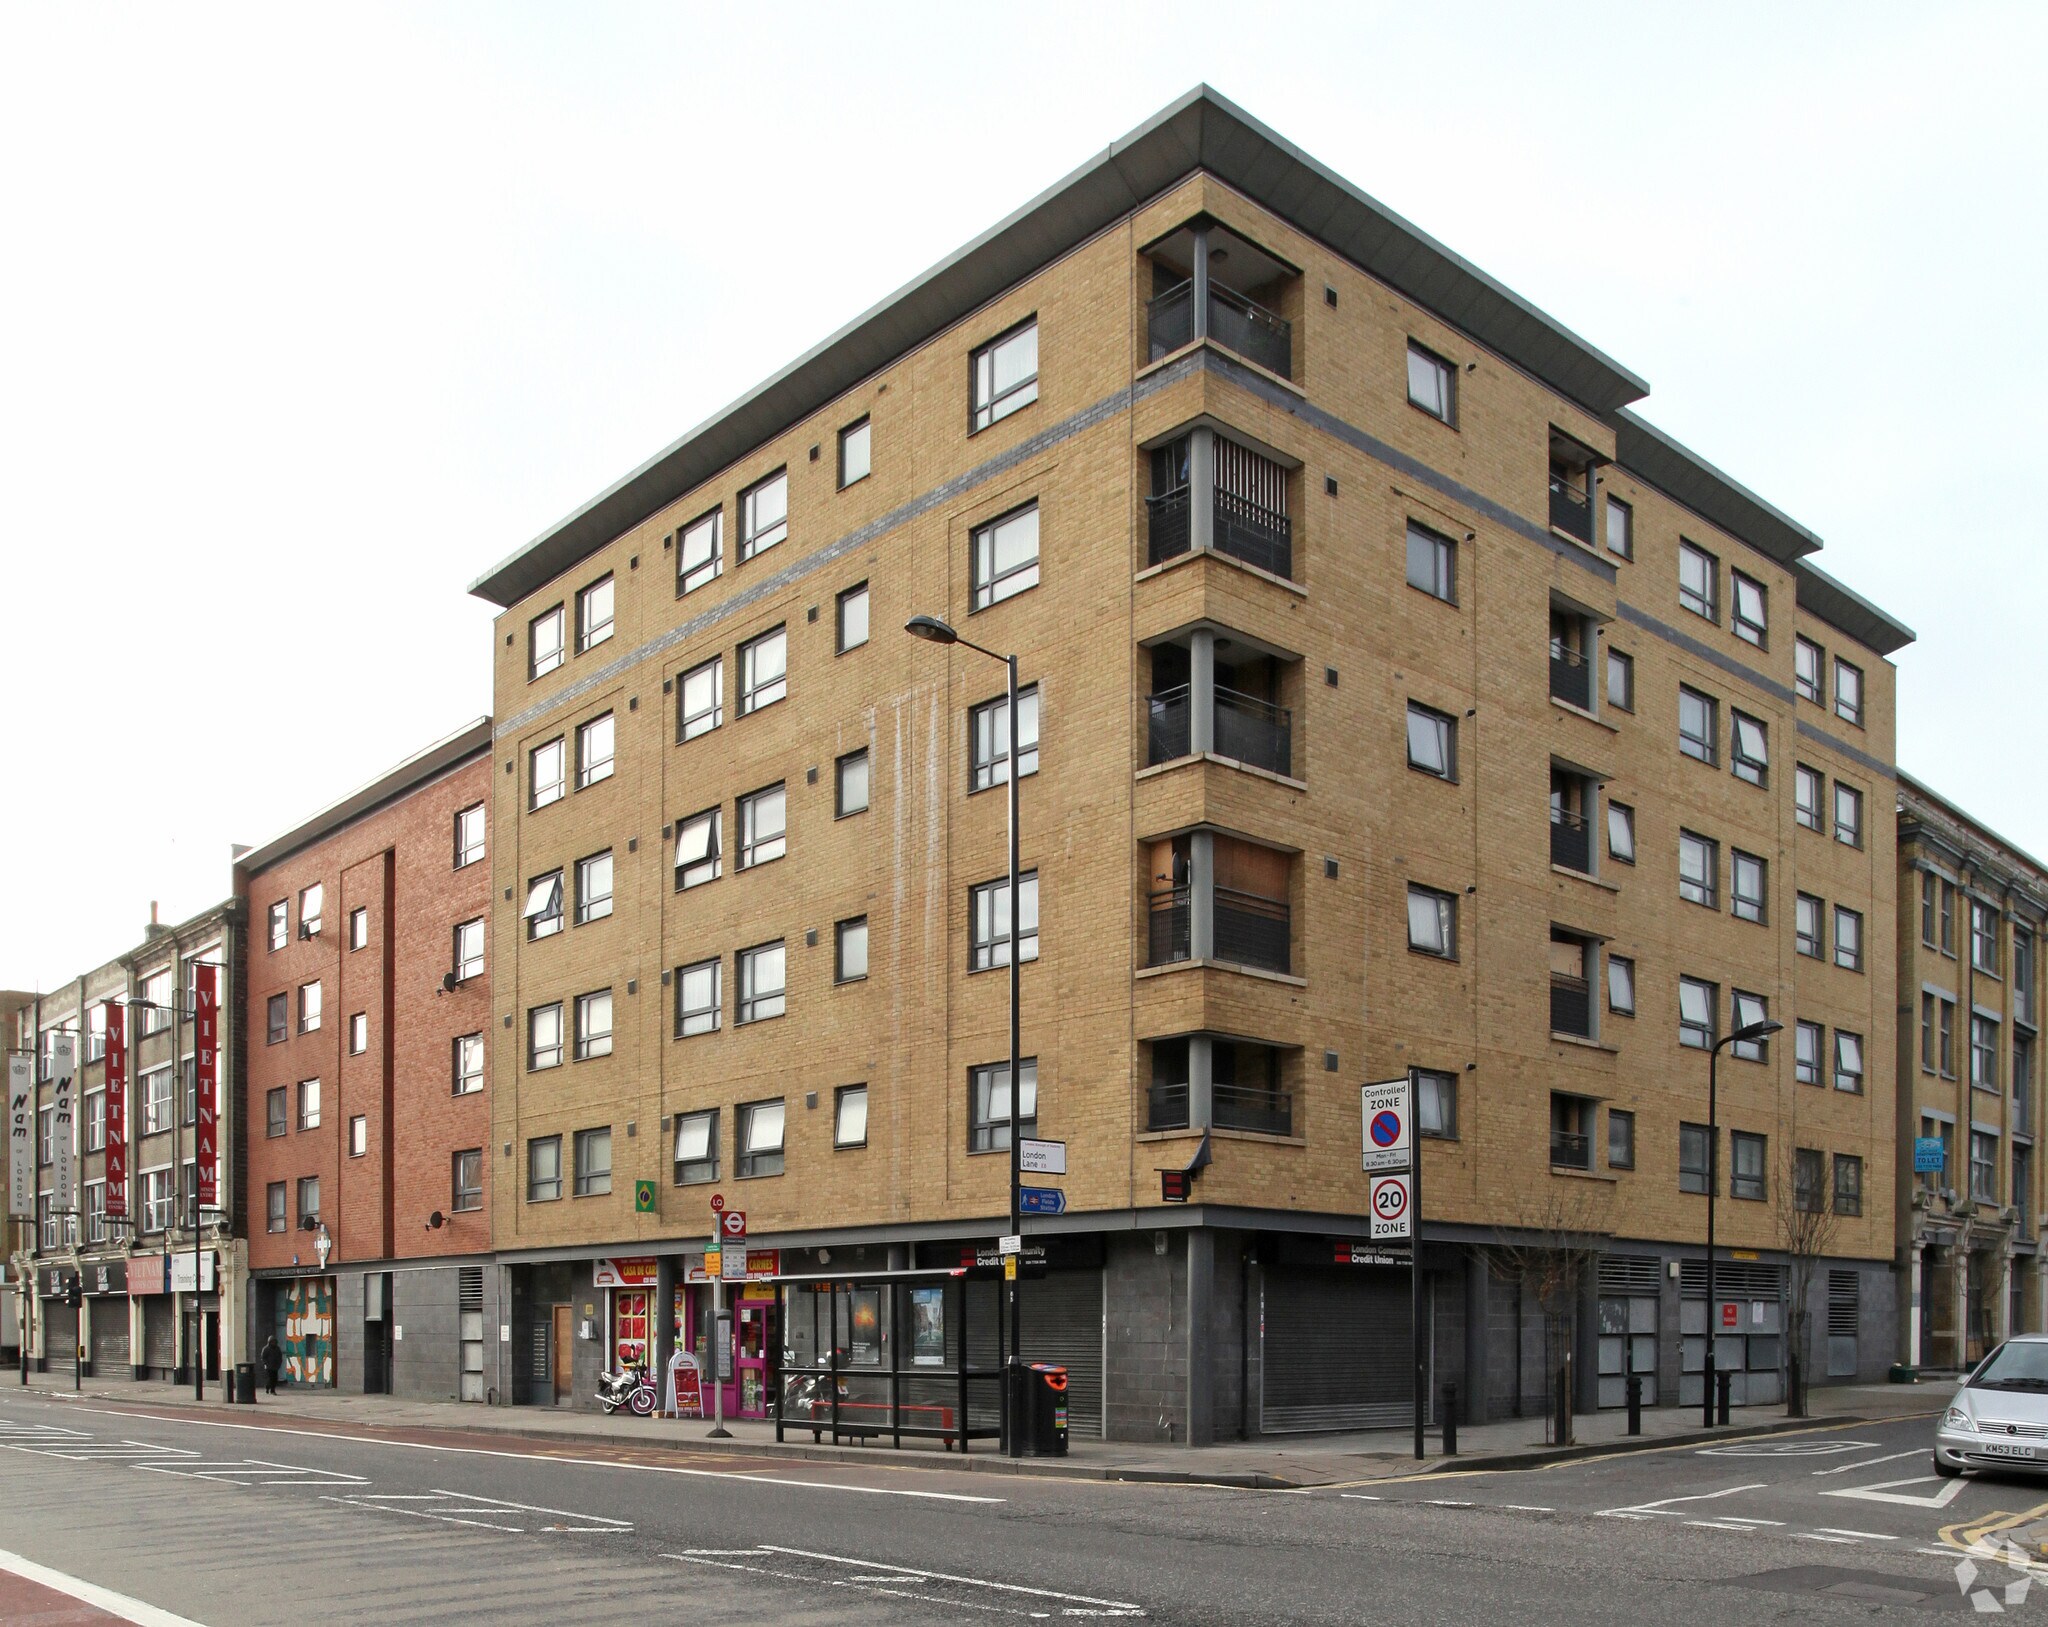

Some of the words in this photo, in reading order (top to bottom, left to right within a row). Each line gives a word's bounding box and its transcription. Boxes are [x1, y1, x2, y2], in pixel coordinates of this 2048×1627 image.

[200, 991, 214, 1183] VIETNAM
[1365, 1085, 1406, 1097] Controlled
[56, 1076, 72, 1124] Nam
[1371, 1097, 1400, 1110] ZONE
[12, 1093, 28, 1138] Nam
[108, 1027, 123, 1197] VIETNAM
[1022, 1150, 1046, 1160] London
[1022, 1159, 1038, 1168] Lane
[1378, 1191, 1402, 1209] 20
[1375, 1222, 1406, 1234] ZONE
[976, 1248, 1000, 1257] Londo
[1352, 1244, 1377, 1253] London
[748, 1259, 773, 1271] CARNES
[976, 1257, 999, 1266] Credit
[1351, 1254, 1373, 1264] Credit
[1374, 1255, 1394, 1265] Union
[623, 1265, 637, 1276] CASA
[637, 1265, 645, 1275] DE
[1985, 1444, 2010, 1453] KM53
[2012, 1446, 2031, 1456] ELC
